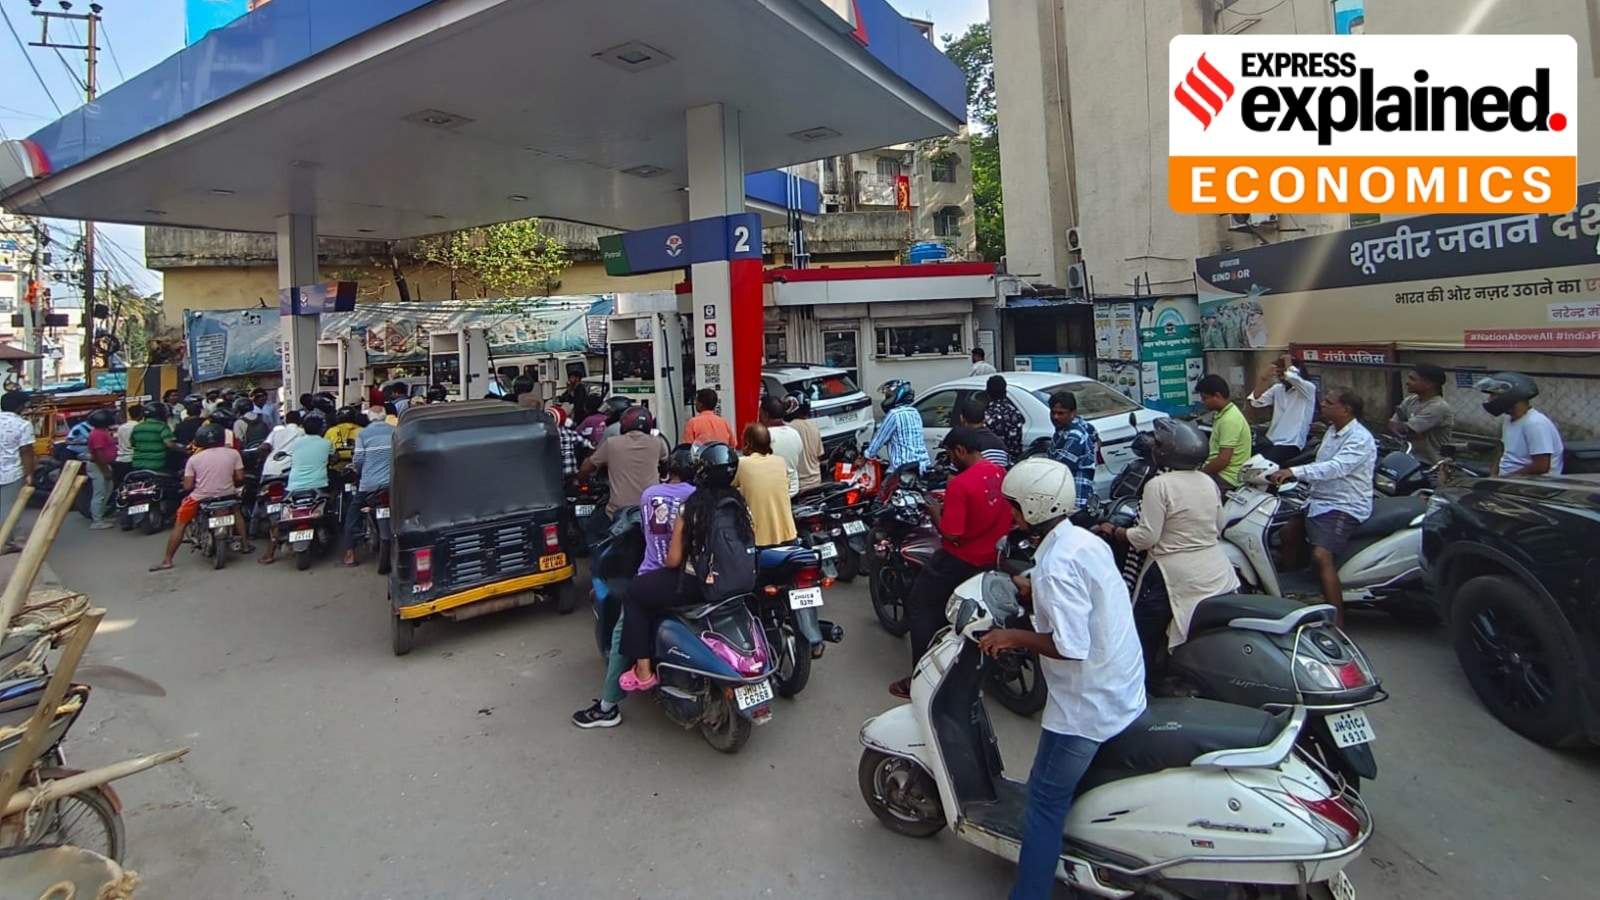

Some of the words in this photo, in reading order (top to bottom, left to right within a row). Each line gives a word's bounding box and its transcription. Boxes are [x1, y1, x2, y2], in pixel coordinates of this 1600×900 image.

[734, 226, 750, 252] 2
[1350, 224, 1431, 275] शूरवीर
[1435, 213, 1540, 253] जवान
[1395, 291, 1424, 304] भारत
[1427, 286, 1444, 303] की
[1447, 285, 1472, 301] ओर
[1512, 277, 1554, 298] उठाने
[1556, 279, 1581, 294] का
[1470, 331, 1553, 342] #NationAboveAll
[1342, 730, 1367, 743] 4930
